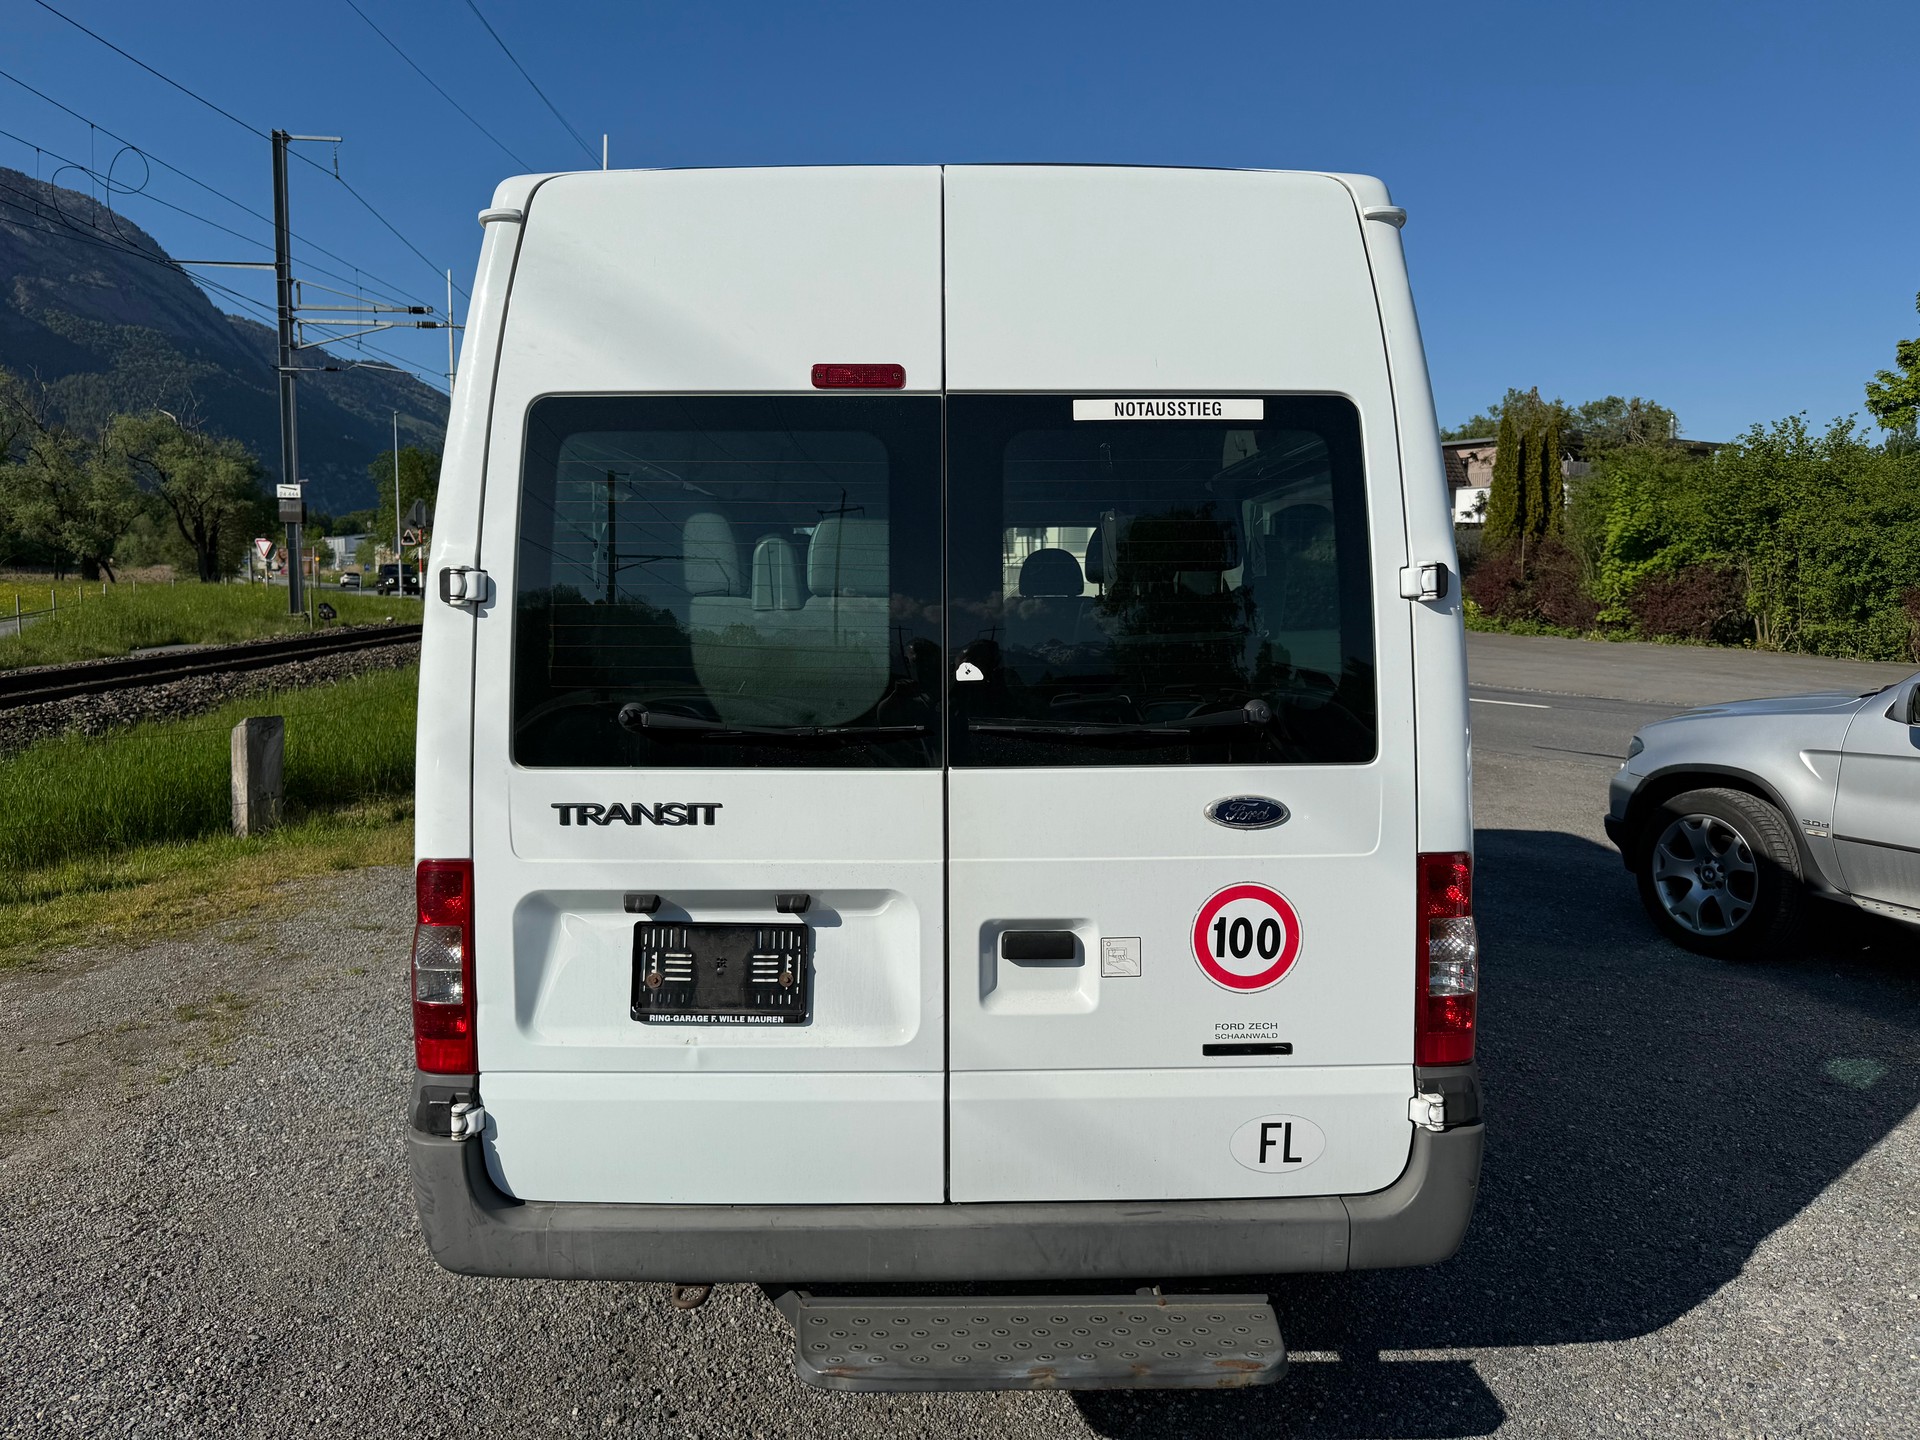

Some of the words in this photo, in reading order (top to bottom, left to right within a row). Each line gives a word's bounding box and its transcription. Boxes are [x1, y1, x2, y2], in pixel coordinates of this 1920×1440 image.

[1114, 402, 1222, 417] NOTAUSSTIEG
[550, 802, 724, 826] TRANSIT
[1225, 801, 1270, 821] Ford
[1213, 917, 1281, 960] 100
[649, 1014, 709, 1023] RING-GARAGE
[711, 1014, 718, 1023] F.
[719, 1015, 745, 1023] WILLE
[747, 1015, 784, 1024] MAUREN
[1214, 1023, 1245, 1031] FORD
[1248, 1022, 1278, 1030] ZECH
[1259, 1122, 1302, 1163] FL
